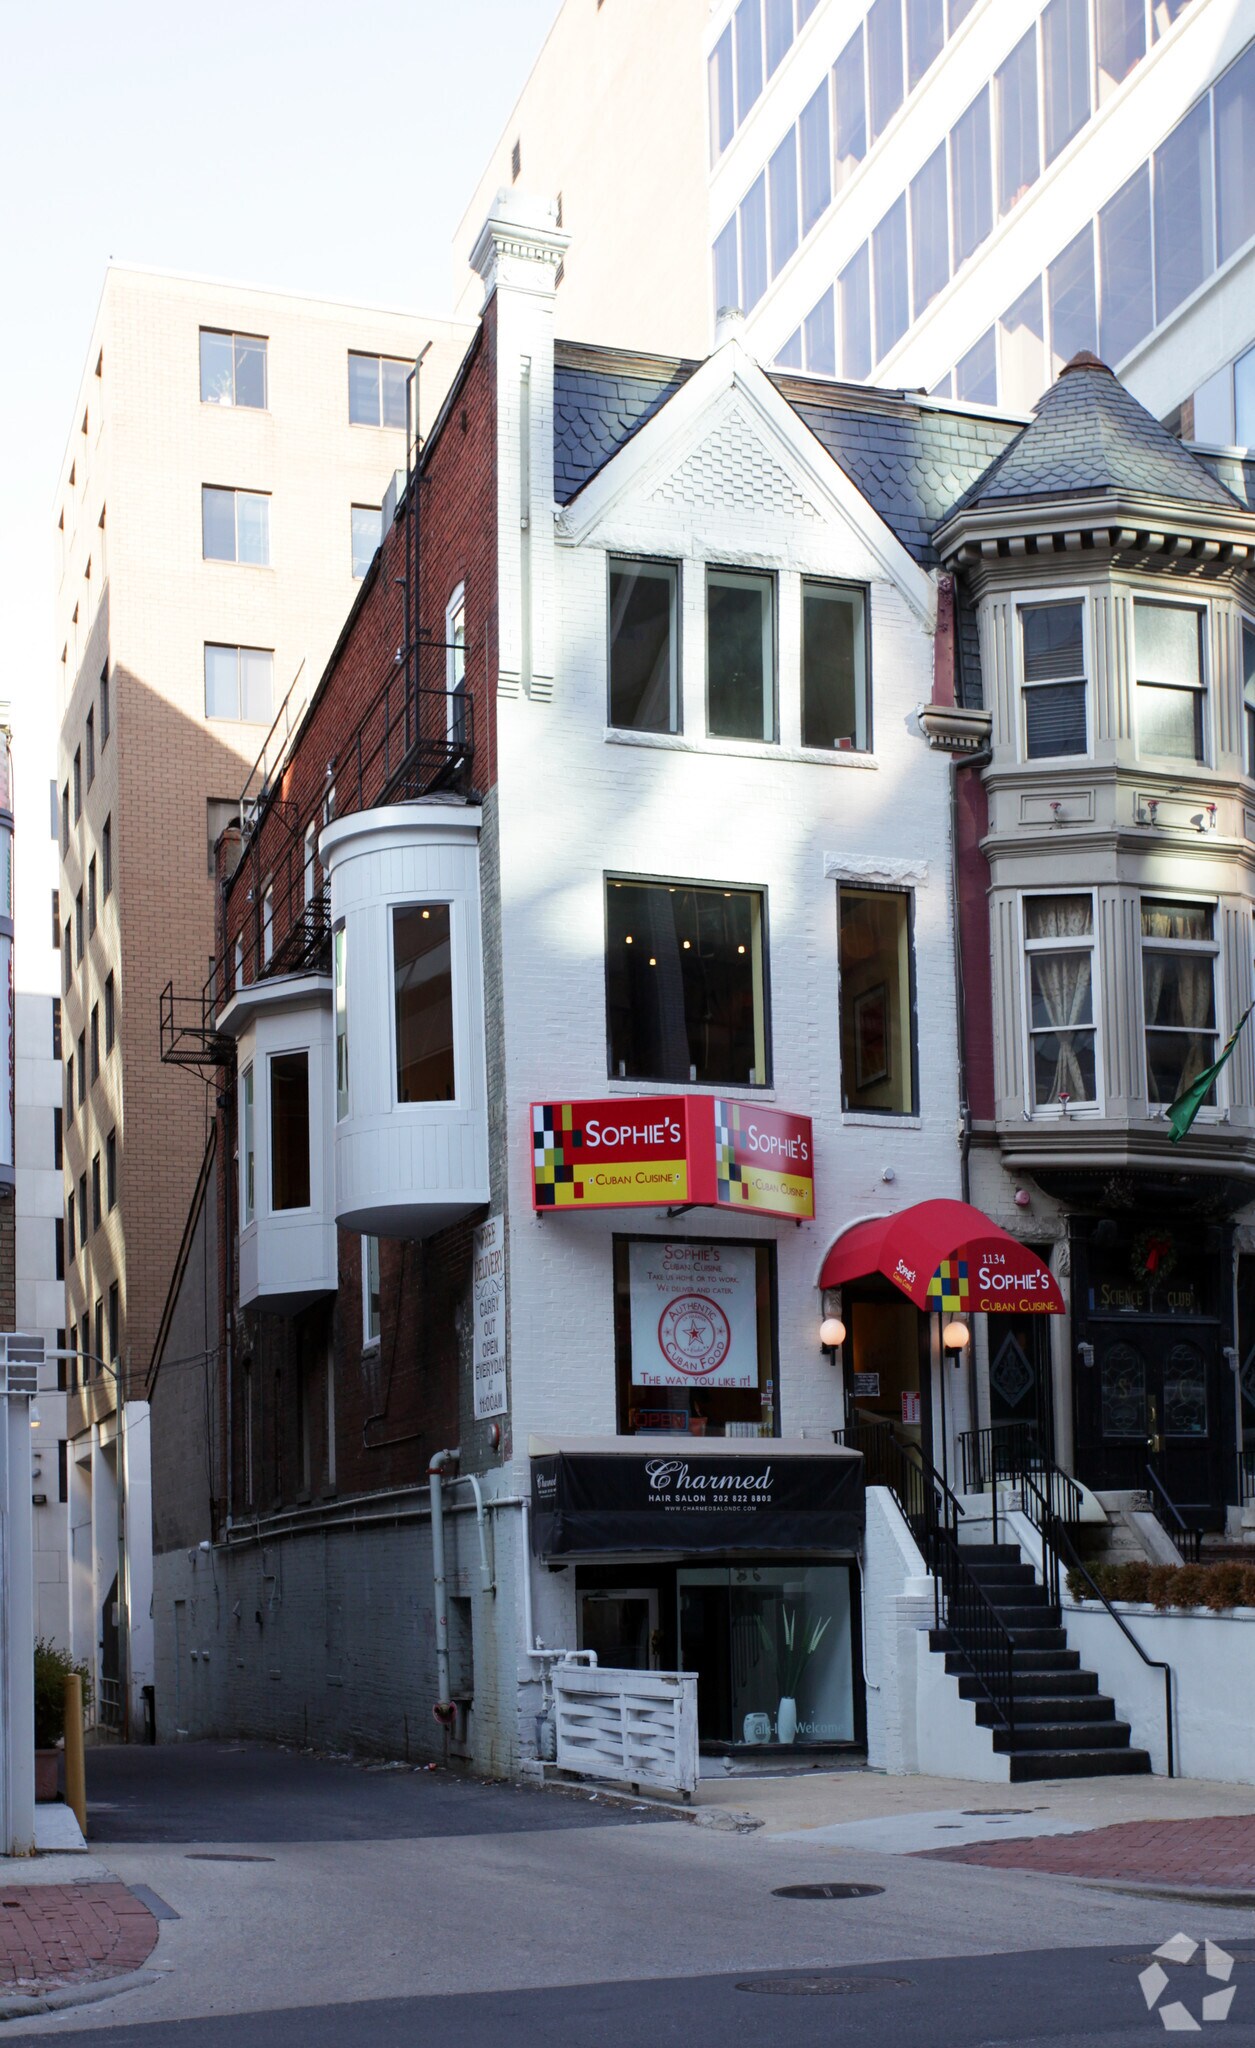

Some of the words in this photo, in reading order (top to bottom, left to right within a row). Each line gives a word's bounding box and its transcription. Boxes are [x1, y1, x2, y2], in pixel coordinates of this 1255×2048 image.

[585, 1116, 681, 1148] SOPHIE'S
[748, 1125, 809, 1161] SOPHIE'S
[595, 1173, 632, 1186] CUBAN
[635, 1171, 673, 1185] CUISINE
[755, 1178, 779, 1193] CUBAN
[780, 1183, 804, 1198] CUISINE
[480, 1221, 496, 1250] FREE
[664, 1244, 720, 1262] SOPHIE'S
[982, 1254, 1006, 1265] 1134
[474, 1247, 505, 1283] DELIVERY
[662, 1260, 691, 1271] CUBAN
[693, 1261, 723, 1273] CUISINE
[647, 1271, 664, 1281] TAKE
[707, 1275, 717, 1283] TO
[978, 1267, 1050, 1290] SOPHIE'S
[656, 1283, 669, 1292] WE
[1101, 1283, 1144, 1306] SCIENCE
[1167, 1290, 1192, 1307] CLUB
[480, 1295, 500, 1318] CARRY
[668, 1302, 718, 1322] AUTHENTIC
[980, 1299, 1016, 1312] CUBAN
[1019, 1299, 1055, 1312] CUISINE
[484, 1318, 496, 1337] OUT
[482, 1338, 499, 1358] OPEN
[666, 1342, 698, 1371] CUBAN
[699, 1341, 725, 1370] FOOD
[475, 1356, 505, 1380] EVERYDAY
[640, 1372, 661, 1385] THE
[665, 1376, 689, 1385] WAY
[693, 1376, 715, 1386] YOU
[717, 1377, 736, 1387] LIKE
[739, 1375, 751, 1387] IT!
[635, 1412, 686, 1428] OPEN
[645, 1459, 775, 1492] Charmed
[648, 1494, 672, 1503] HAIR
[675, 1494, 707, 1503] SALON
[713, 1494, 729, 1503] 202
[732, 1494, 748, 1503] 822
